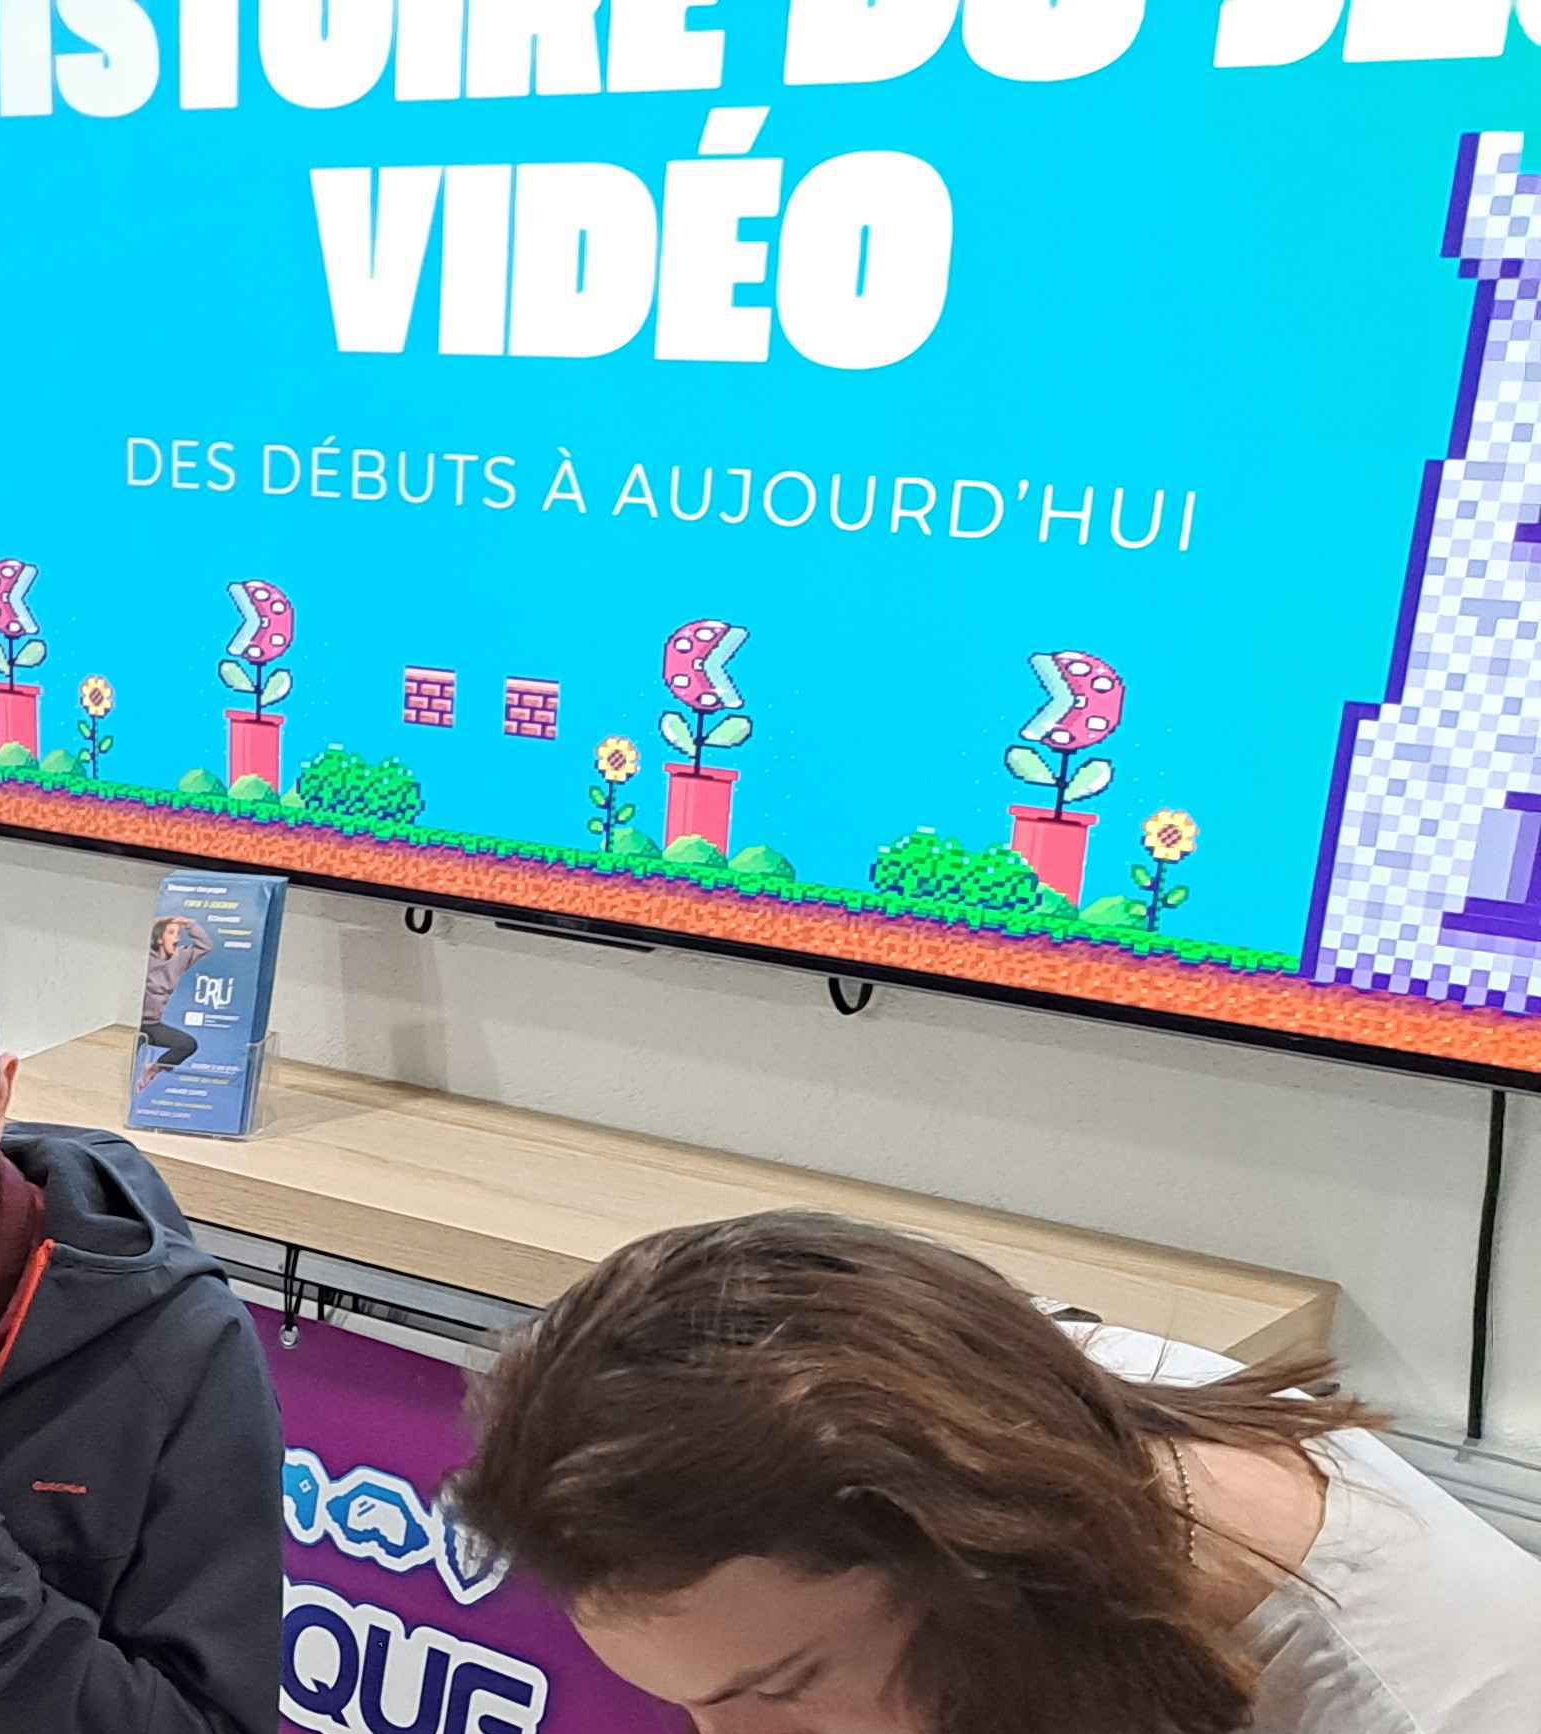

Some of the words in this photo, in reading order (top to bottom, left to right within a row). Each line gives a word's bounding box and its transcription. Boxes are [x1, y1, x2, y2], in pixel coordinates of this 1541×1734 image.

[310, 105, 953, 369] VIDÉO
[126, 436, 235, 492] DES
[263, 436, 517, 510] DÉBUTS
[541, 445, 588, 515] À
[612, 463, 1197, 551] AUJOURD'HUI
